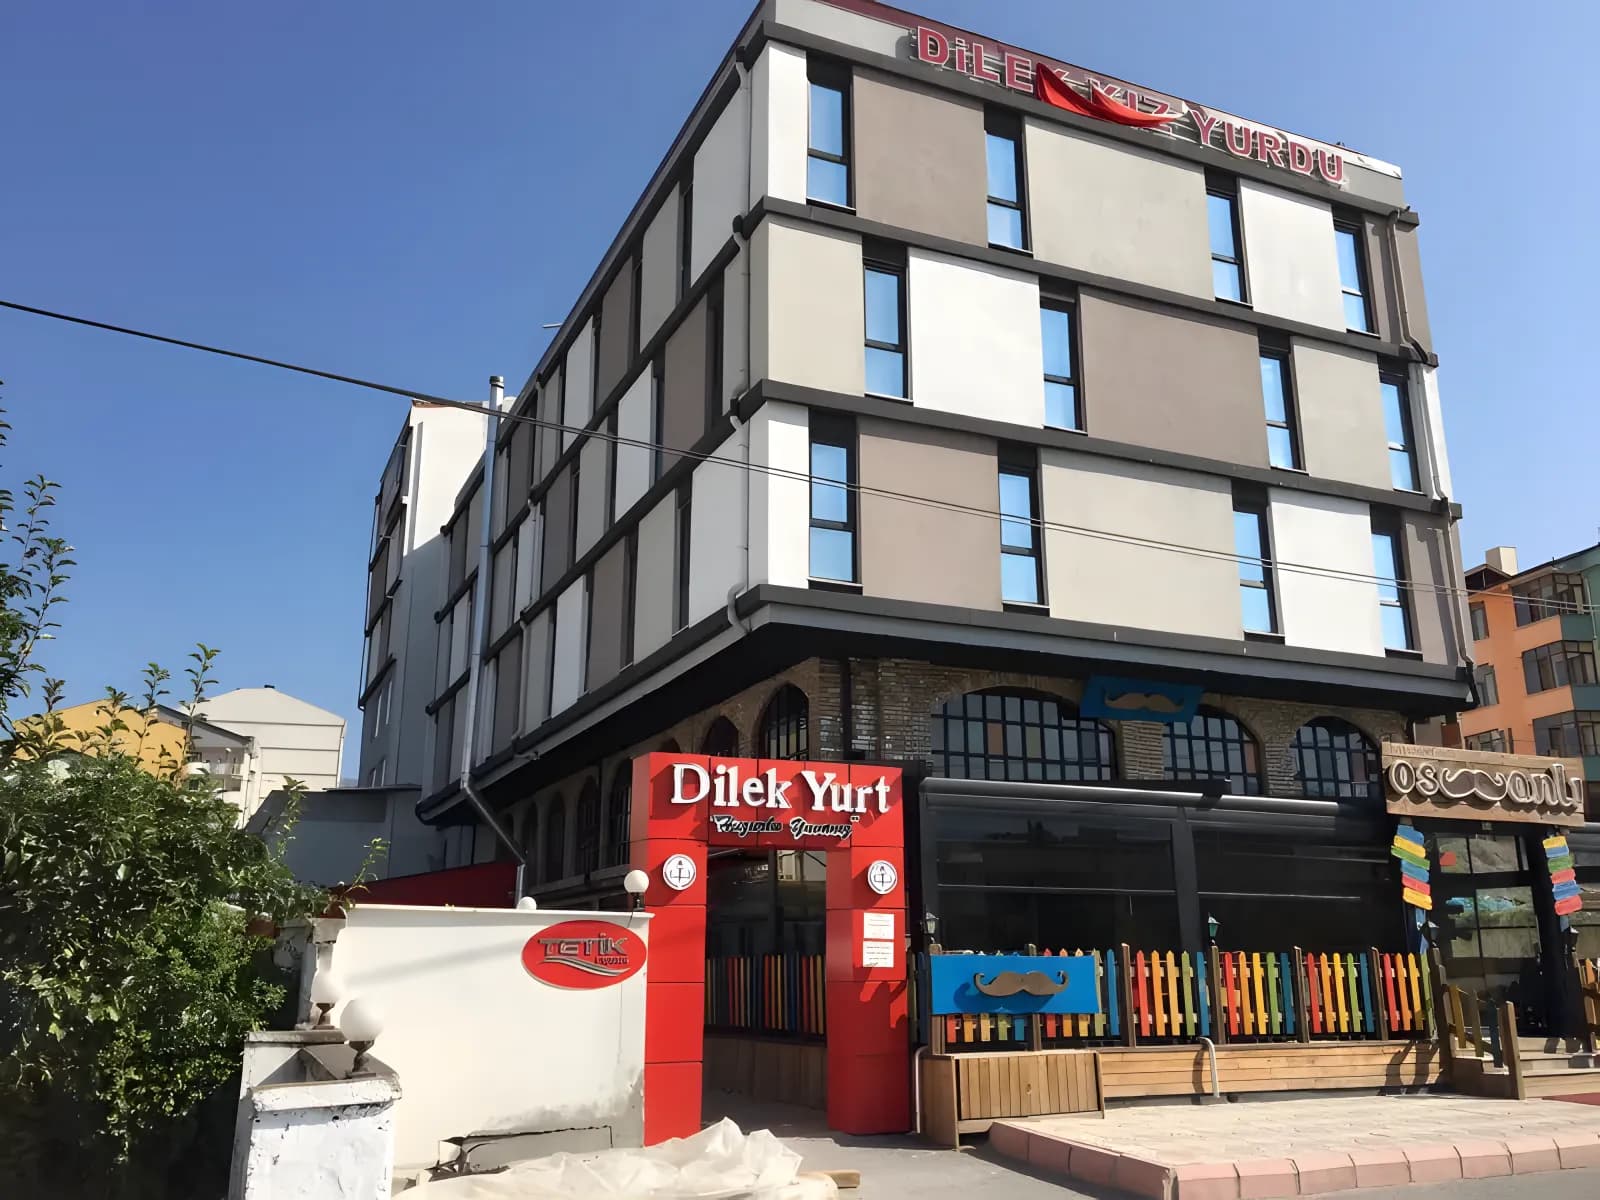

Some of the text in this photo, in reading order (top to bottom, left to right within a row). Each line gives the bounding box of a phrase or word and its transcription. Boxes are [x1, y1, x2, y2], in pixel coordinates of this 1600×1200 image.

[1189, 108, 1346, 185] YURDU
[670, 762, 892, 813] Dilek Yurt
